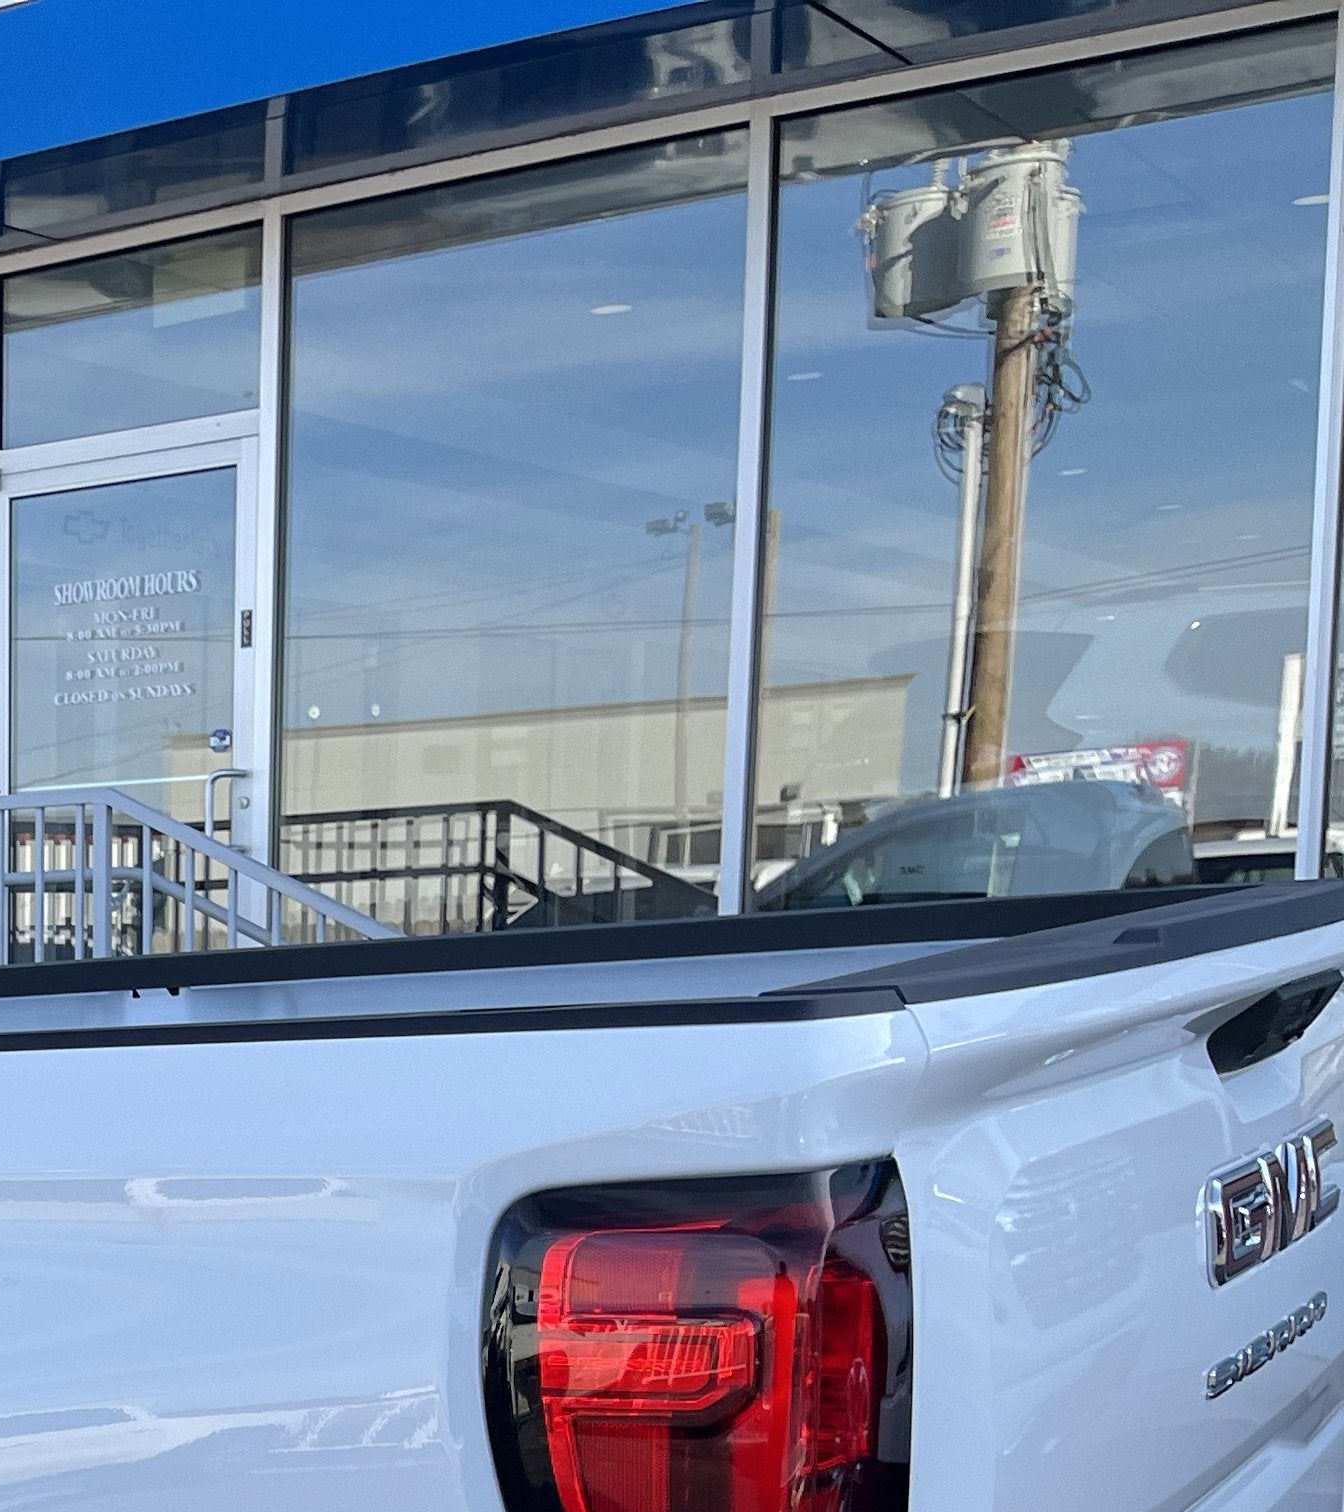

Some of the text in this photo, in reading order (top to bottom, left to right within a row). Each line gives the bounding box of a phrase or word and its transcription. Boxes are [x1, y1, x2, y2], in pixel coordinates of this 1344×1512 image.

[54, 569, 199, 606] SHOWROOM HOURS
[94, 606, 155, 625] MON-FRI
[87, 646, 158, 664] SATURDAY
[53, 689, 109, 706] CLOSED
[128, 684, 194, 701] SUNDAYS
[1204, 1117, 1341, 1290] GMC
[1205, 1290, 1328, 1401] SIERRA
